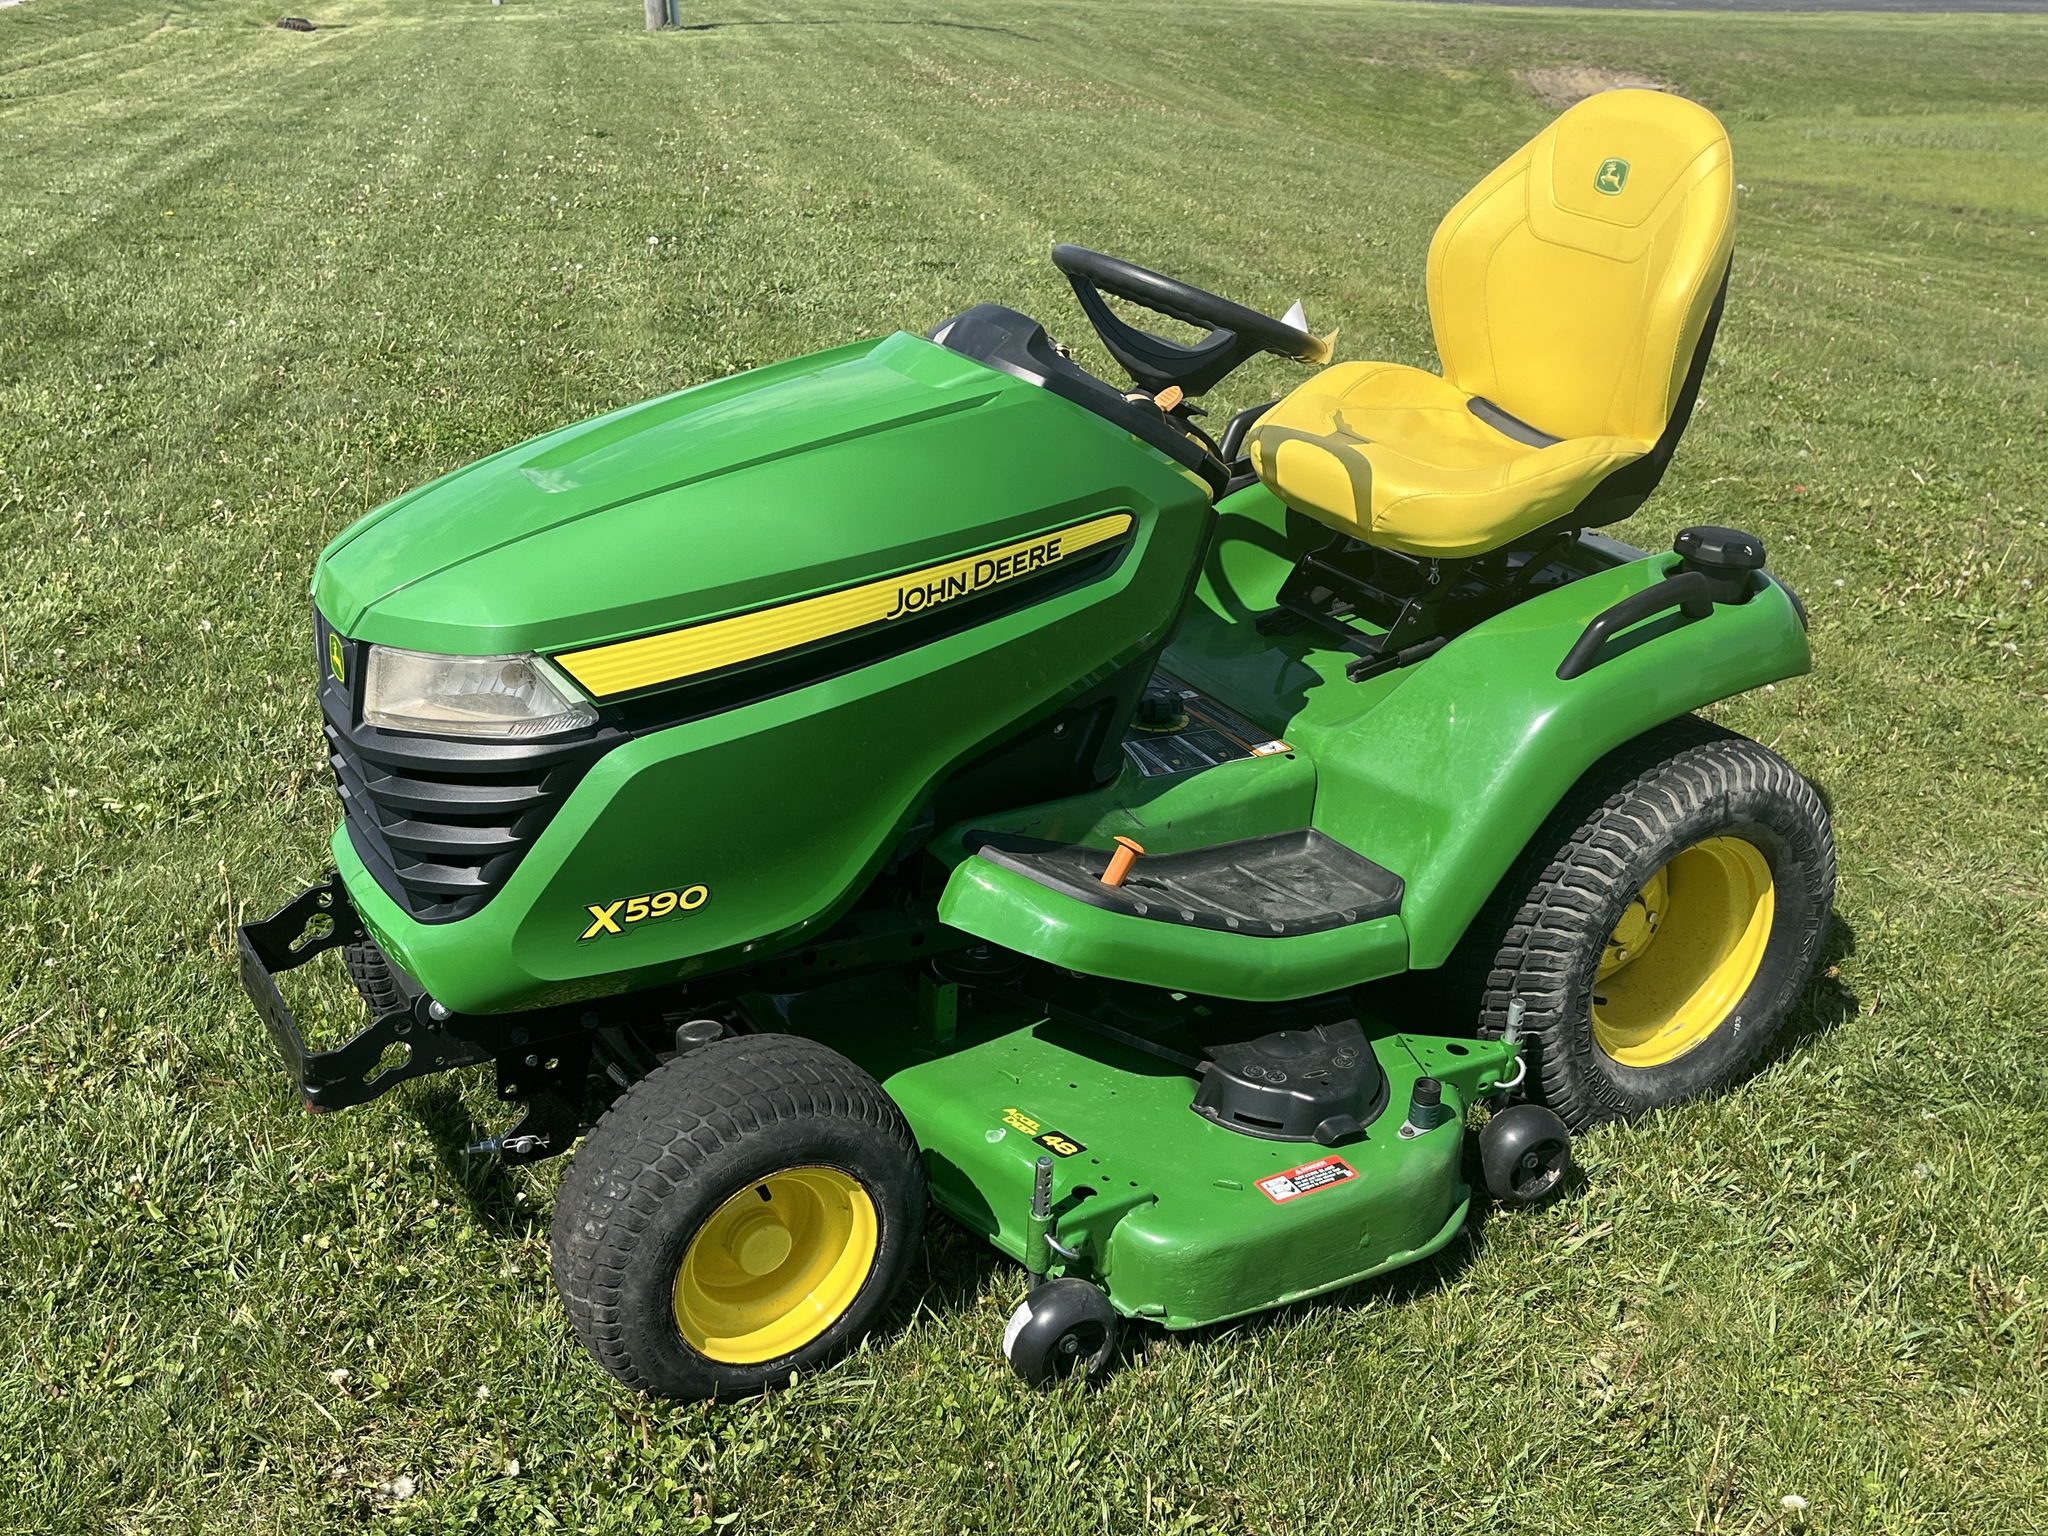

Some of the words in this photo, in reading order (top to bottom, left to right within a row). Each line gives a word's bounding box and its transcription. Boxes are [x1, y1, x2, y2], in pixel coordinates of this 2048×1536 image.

[886, 571, 968, 619] JOHN
[973, 537, 1063, 590] DEERE
[577, 884, 709, 941] X590
[1041, 1135, 1078, 1155] 48
